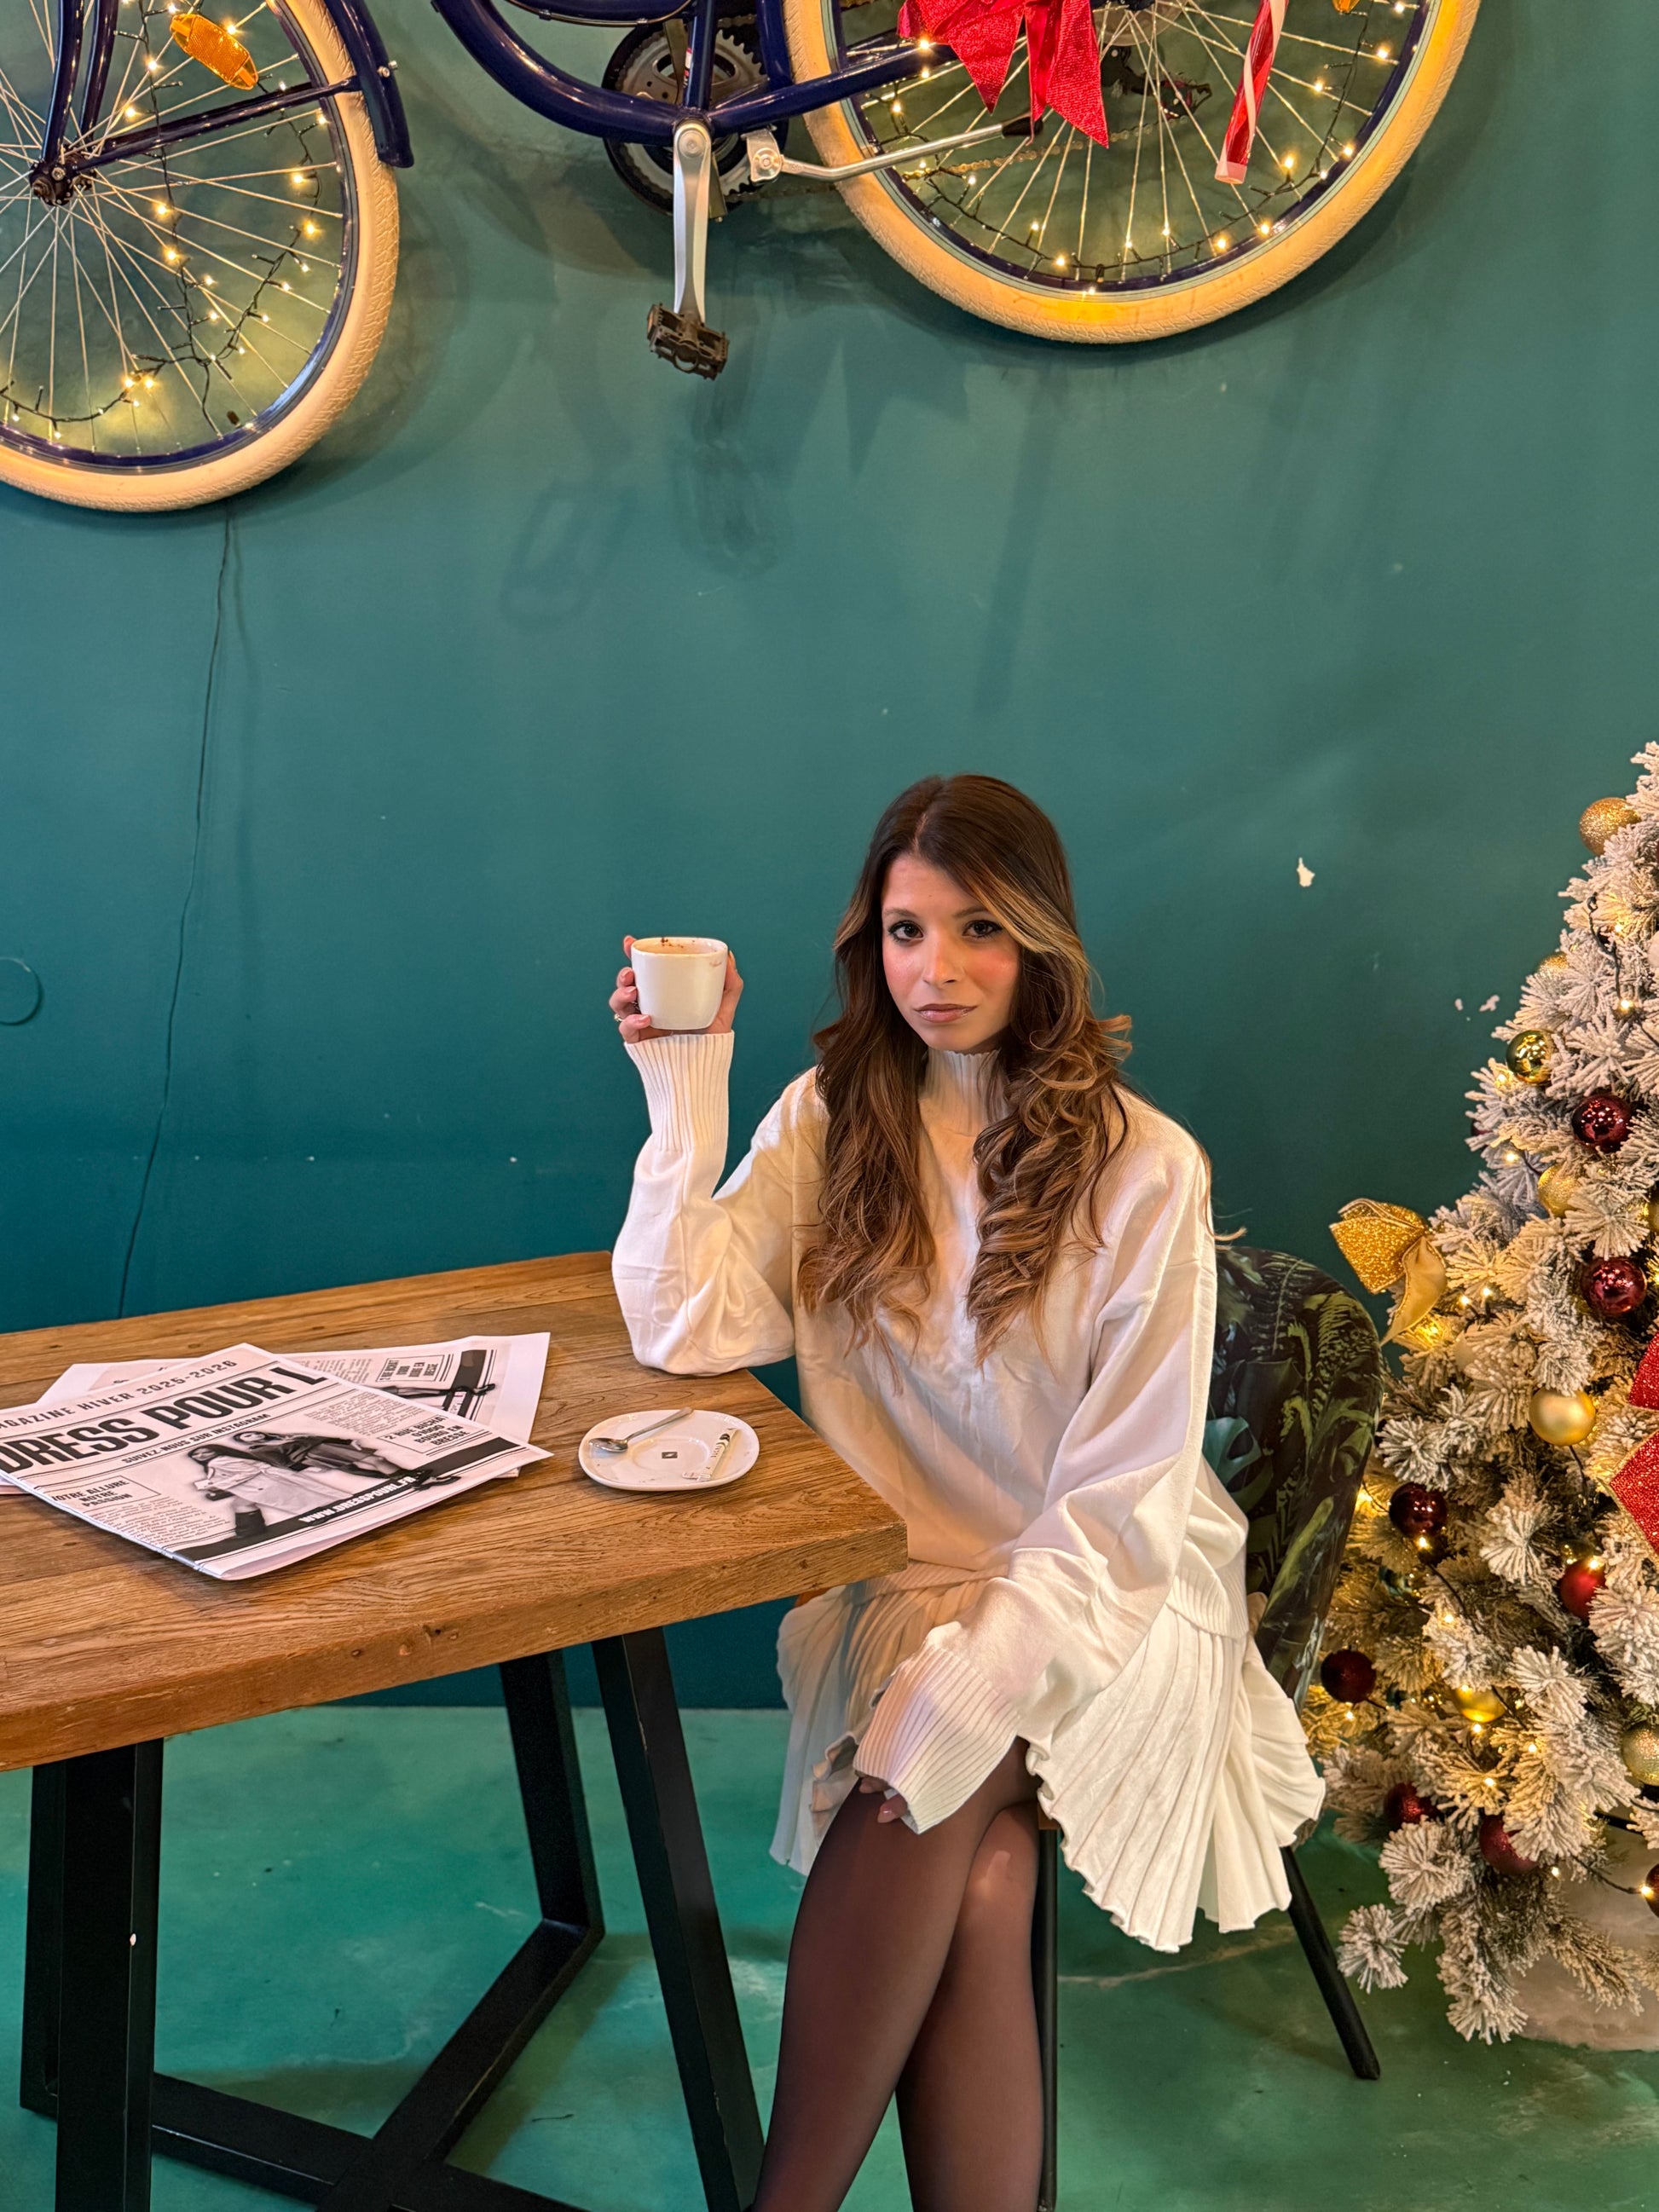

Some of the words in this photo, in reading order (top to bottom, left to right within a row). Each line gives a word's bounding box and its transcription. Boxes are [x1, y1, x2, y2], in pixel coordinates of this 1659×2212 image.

[77, 1393, 135, 1411] HIVER
[136, 1360, 238, 1395] 2025-2026
[0, 1418, 159, 1474] DRESS
[139, 1377, 298, 1430] POUR
[269, 1366, 328, 1385] L
[121, 1440, 191, 1464] SUIVEZ-NOUS
[189, 1433, 214, 1442] SUR
[212, 1413, 271, 1435] INSTAGRAM
[393, 1428, 417, 1436] RUE
[430, 1431, 470, 1446] BRESSE
[86, 1480, 130, 1495] ALLURE
[78, 1490, 118, 1502] NOTRE
[82, 1493, 133, 1507] PASSION
[298, 1476, 417, 1522] WWW.DRESSPOURL.FR
